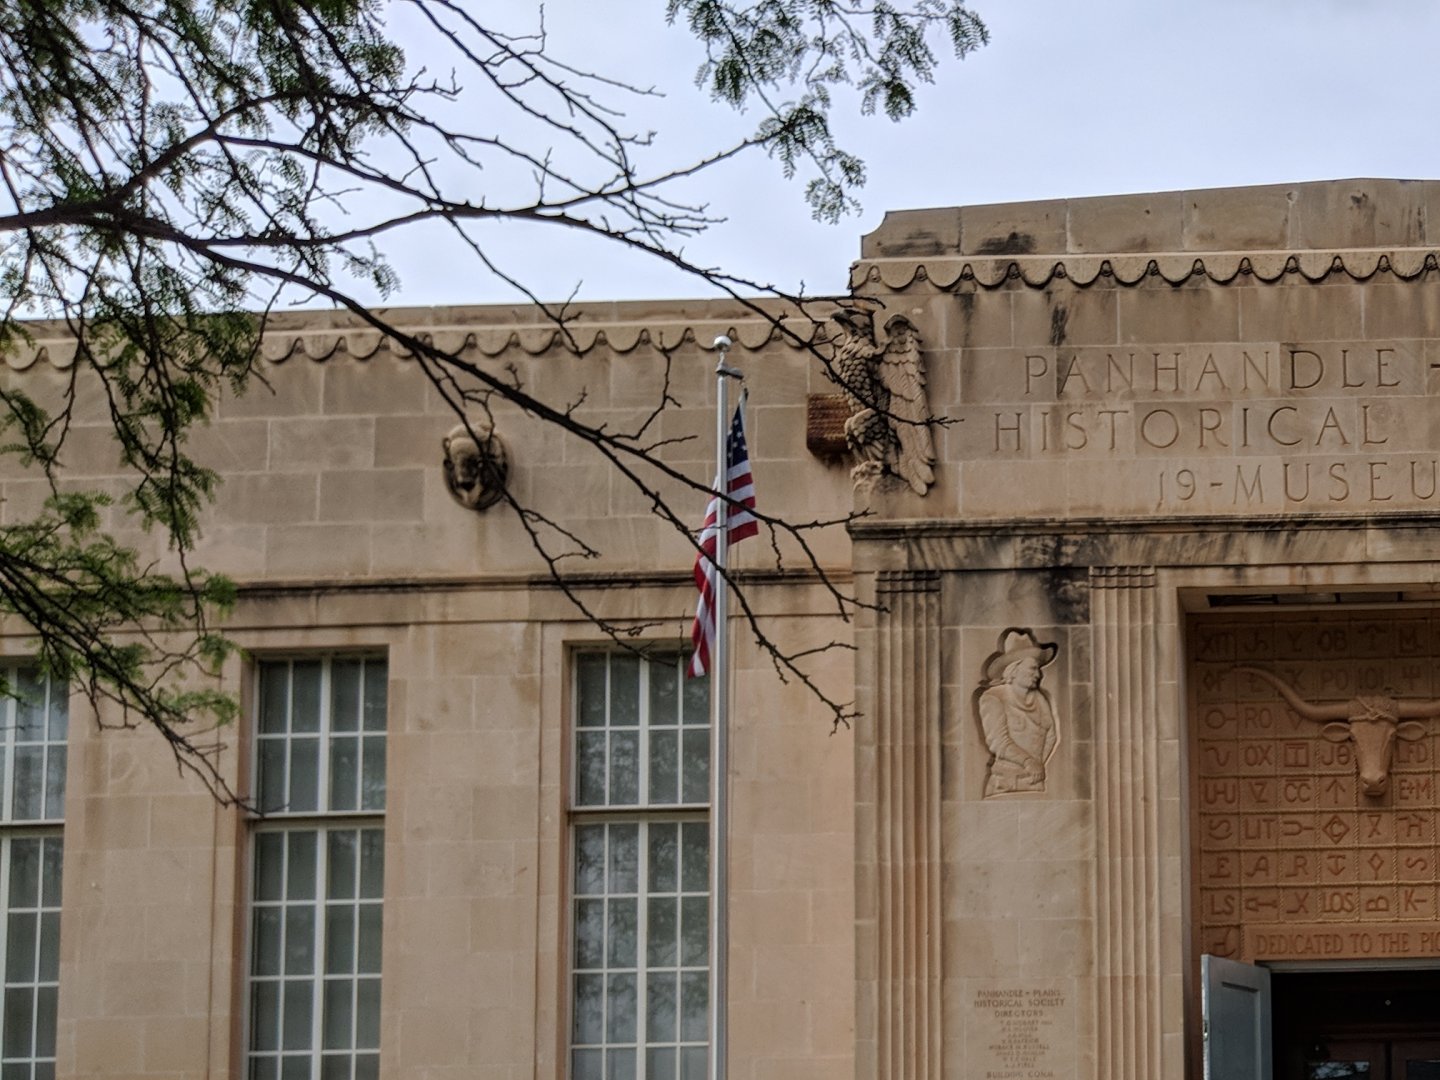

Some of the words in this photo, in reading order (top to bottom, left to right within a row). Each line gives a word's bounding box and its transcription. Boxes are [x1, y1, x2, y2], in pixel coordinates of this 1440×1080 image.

[1024, 348, 1401, 395] PANHANDLE
[994, 405, 1389, 451] HISTORICAL
[1255, 934, 1343, 955] DEDICATED
[1350, 933, 1373, 954] TO
[1378, 932, 1409, 952] THE
